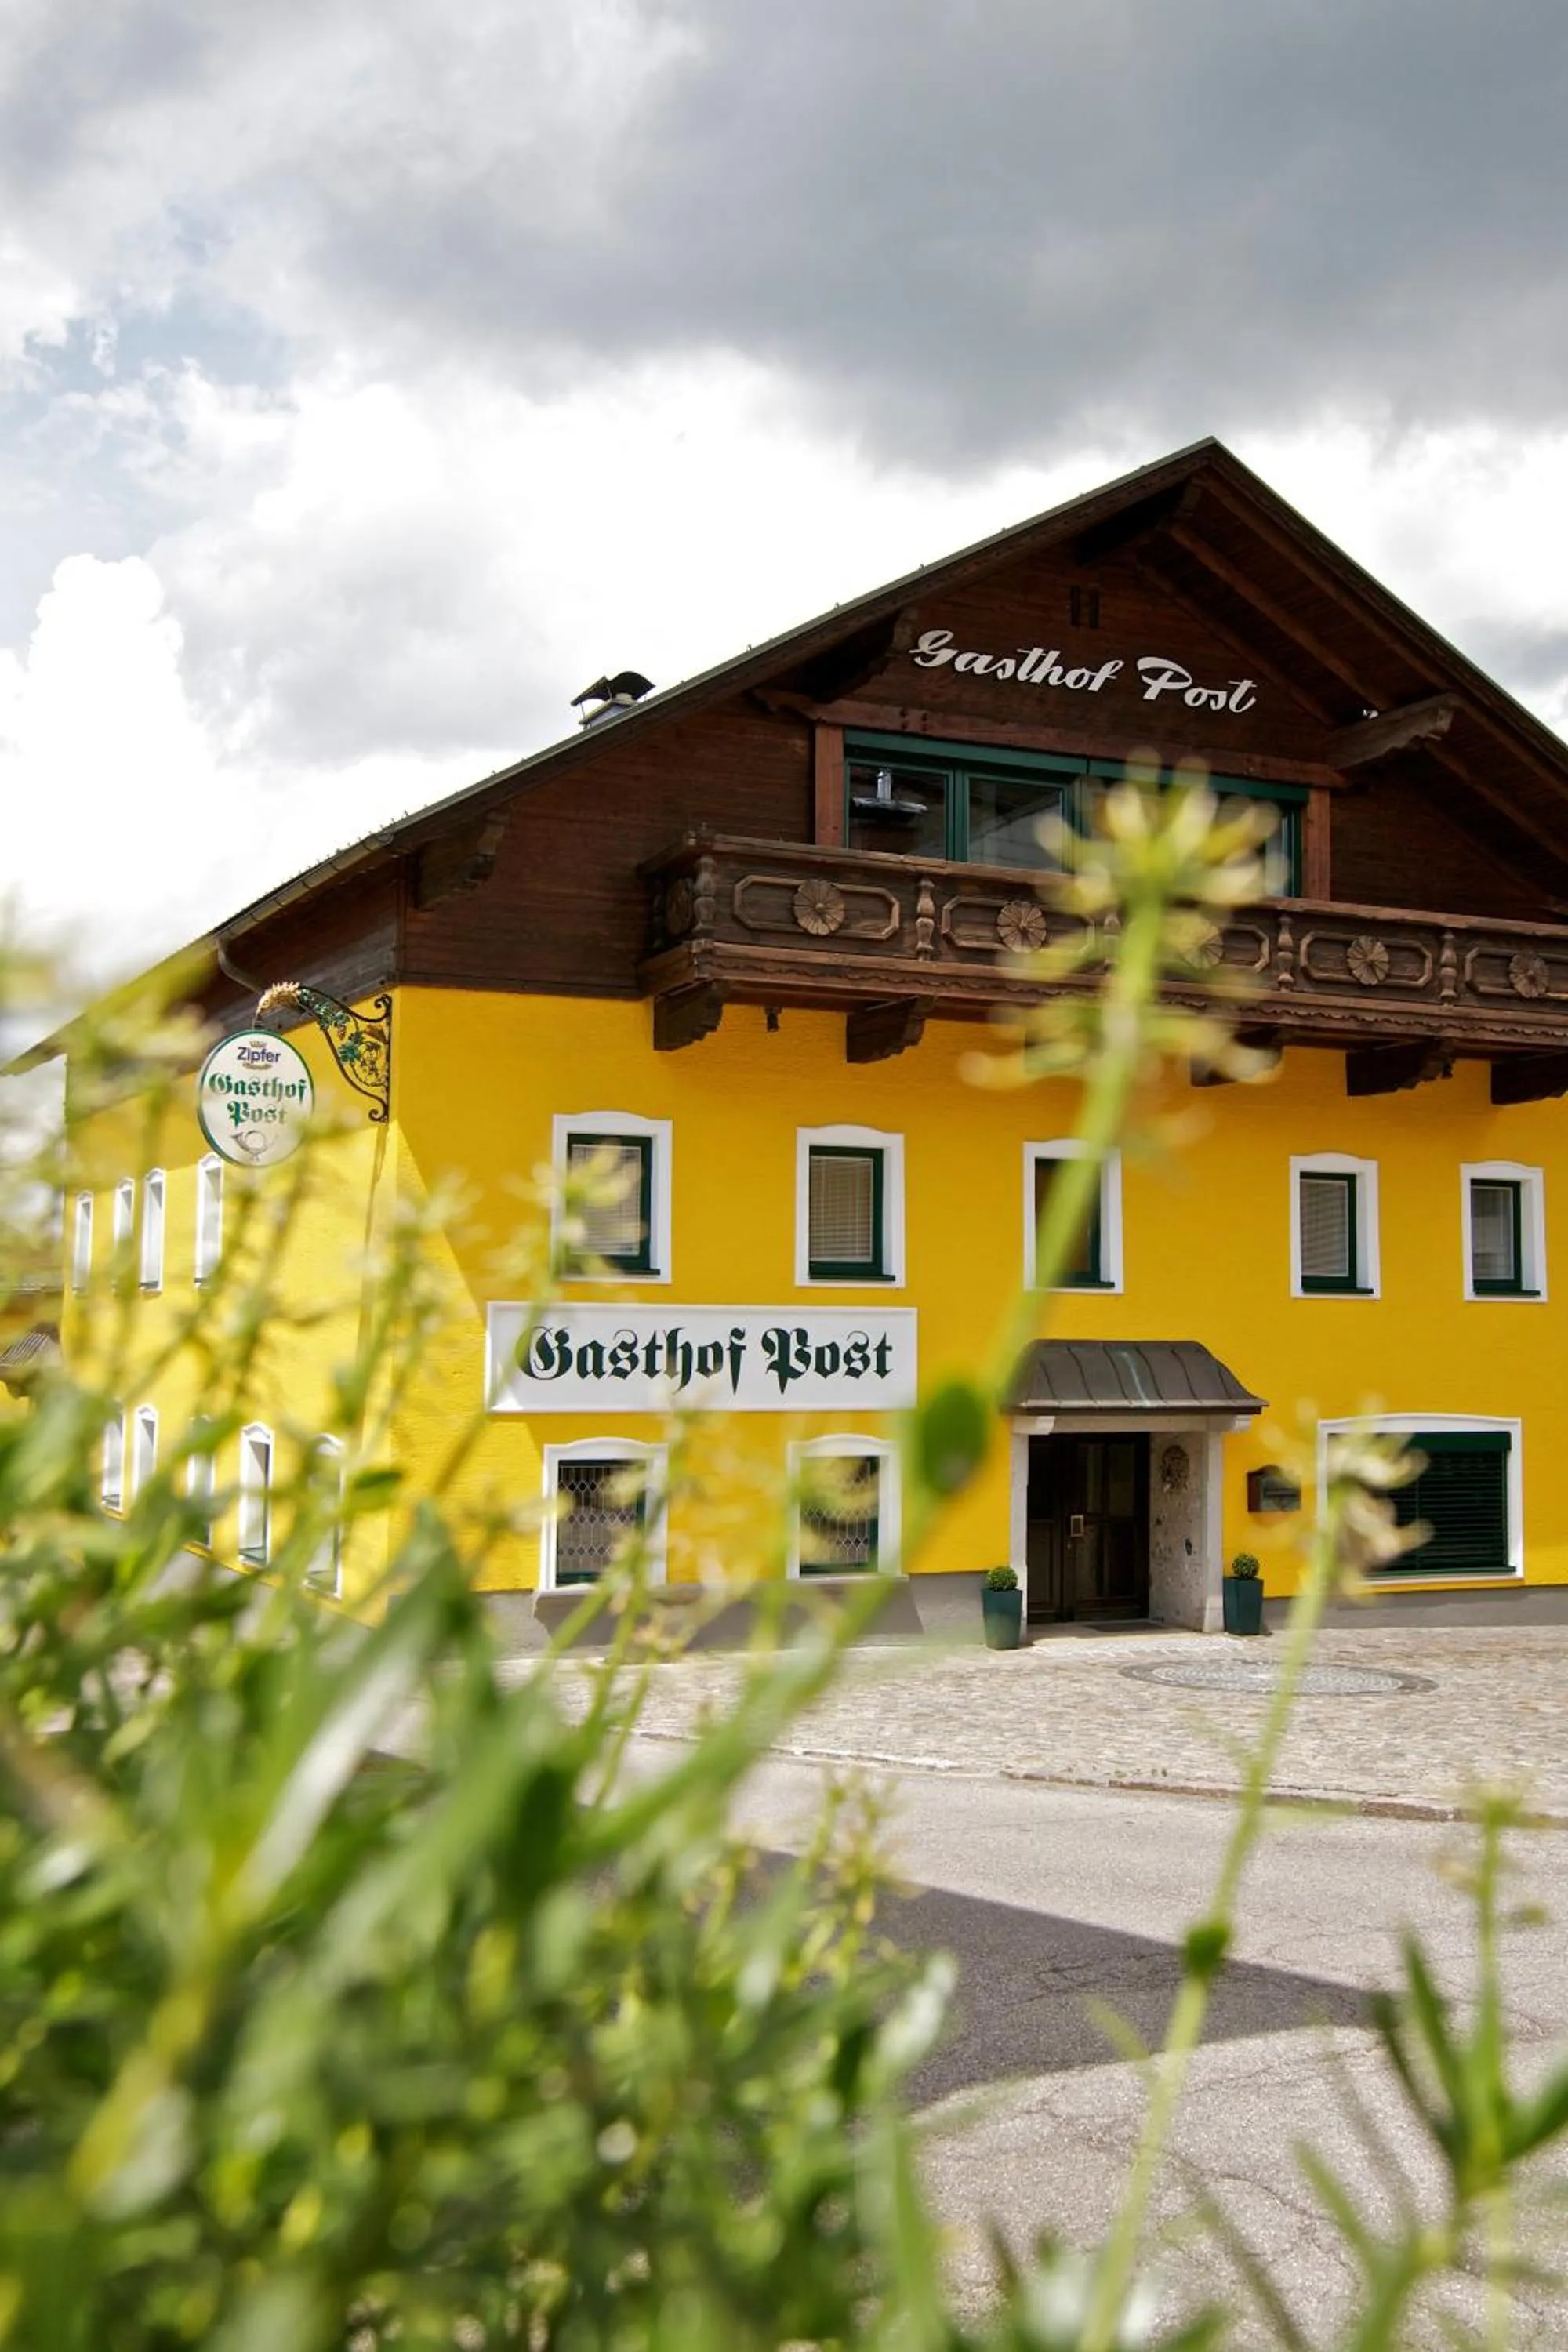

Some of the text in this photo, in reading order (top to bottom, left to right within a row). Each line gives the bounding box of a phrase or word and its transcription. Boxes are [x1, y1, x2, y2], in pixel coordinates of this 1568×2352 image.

[909, 630, 1258, 713] Gasthof Post
[237, 1047, 281, 1063] Zipfer
[208, 1073, 307, 1105] Gasthof
[227, 1101, 288, 1128] Post
[514, 1326, 892, 1395] Gasthof Post
